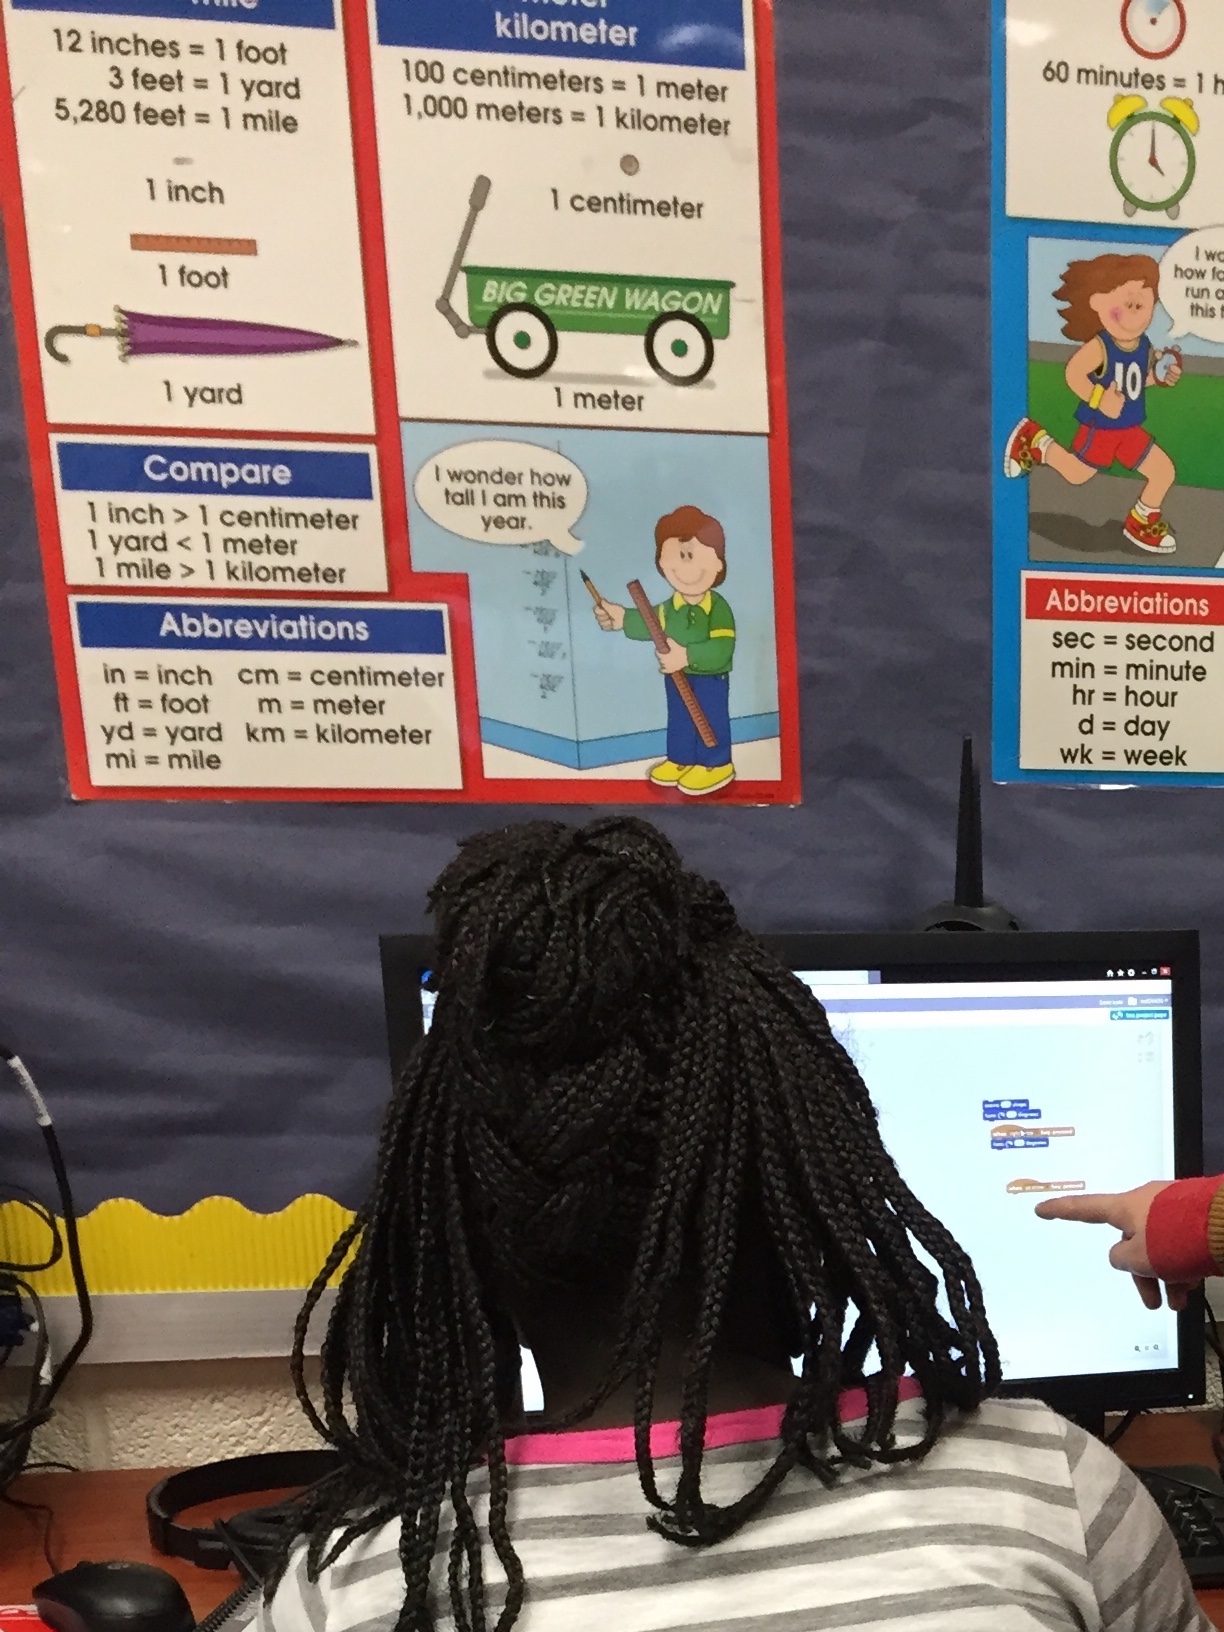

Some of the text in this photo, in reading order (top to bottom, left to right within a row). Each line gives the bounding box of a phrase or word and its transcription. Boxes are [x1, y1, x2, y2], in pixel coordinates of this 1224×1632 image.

[495, 11, 638, 47] kilometer
[53, 29, 84, 52] 12
[91, 31, 180, 59] inches
[216, 38, 224, 61] 1
[236, 39, 287, 65] foot
[109, 66, 124, 89] 3
[132, 67, 183, 92] feet
[220, 72, 229, 94] 1
[240, 77, 300, 101] yard
[403, 59, 445, 84] 100
[453, 66, 604, 94] centimeters
[637, 74, 645, 97] 1
[657, 79, 728, 102] meter
[1043, 61, 1069, 83] 60
[1077, 65, 1166, 91] minutes
[1197, 73, 1203, 93] 1
[55, 97, 126, 124] 5,280
[133, 102, 185, 126] feet
[221, 107, 230, 129] 1
[242, 109, 298, 133] mile
[404, 93, 467, 119] 1,000
[476, 101, 562, 125] meters
[597, 106, 604, 127] 1
[615, 106, 730, 136] kilometer
[146, 178, 224, 204] 1 inch
[551, 188, 703, 219] 1 centimeter
[159, 264, 228, 289] 1 foot
[1174, 264, 1206, 280] how
[482, 280, 722, 315] BIG GREEN WAGON
[1185, 287, 1210, 299] run
[1190, 303, 1216, 318] this
[163, 380, 242, 408] 1 yard
[1111, 362, 1141, 405] 10
[554, 387, 644, 411] 1 meter
[144, 455, 291, 489] Compare
[435, 465, 571, 487] I wonder how
[445, 488, 566, 509] tall I am this
[88, 501, 96, 522] 1
[108, 502, 164, 524] inch
[199, 504, 208, 526] 1
[220, 506, 359, 530] centimeter
[481, 515, 532, 532] year.
[88, 529, 97, 550] 1
[108, 531, 167, 556] yard
[202, 532, 211, 553] 1
[223, 534, 297, 555] meter
[96, 557, 104, 577] 1
[117, 558, 171, 580] mile
[206, 559, 214, 580] 1
[226, 561, 346, 584] kilometer
[1046, 589, 1209, 616] Abbreviations
[160, 612, 369, 640] Abbreviations
[1052, 631, 1095, 649] sec
[1125, 631, 1214, 652] second
[103, 663, 125, 683] in
[157, 665, 212, 685] inch
[238, 668, 278, 685] cm
[310, 666, 444, 687] centimeter
[1052, 657, 1095, 678] min
[1126, 659, 1206, 682] minute
[114, 692, 129, 712] ft
[161, 693, 209, 714] foot
[258, 698, 282, 713] m
[313, 694, 385, 715] meter
[1073, 684, 1095, 705] hr
[1125, 685, 1178, 707] hour
[101, 721, 134, 745] yd
[165, 722, 222, 746] yard
[246, 723, 285, 742] km
[316, 723, 431, 745] kilometer
[1078, 714, 1094, 735] d
[1124, 715, 1170, 741] day
[106, 749, 136, 768] mi
[168, 750, 221, 770] mile
[1060, 743, 1093, 764] wk
[1124, 745, 1187, 766] week
